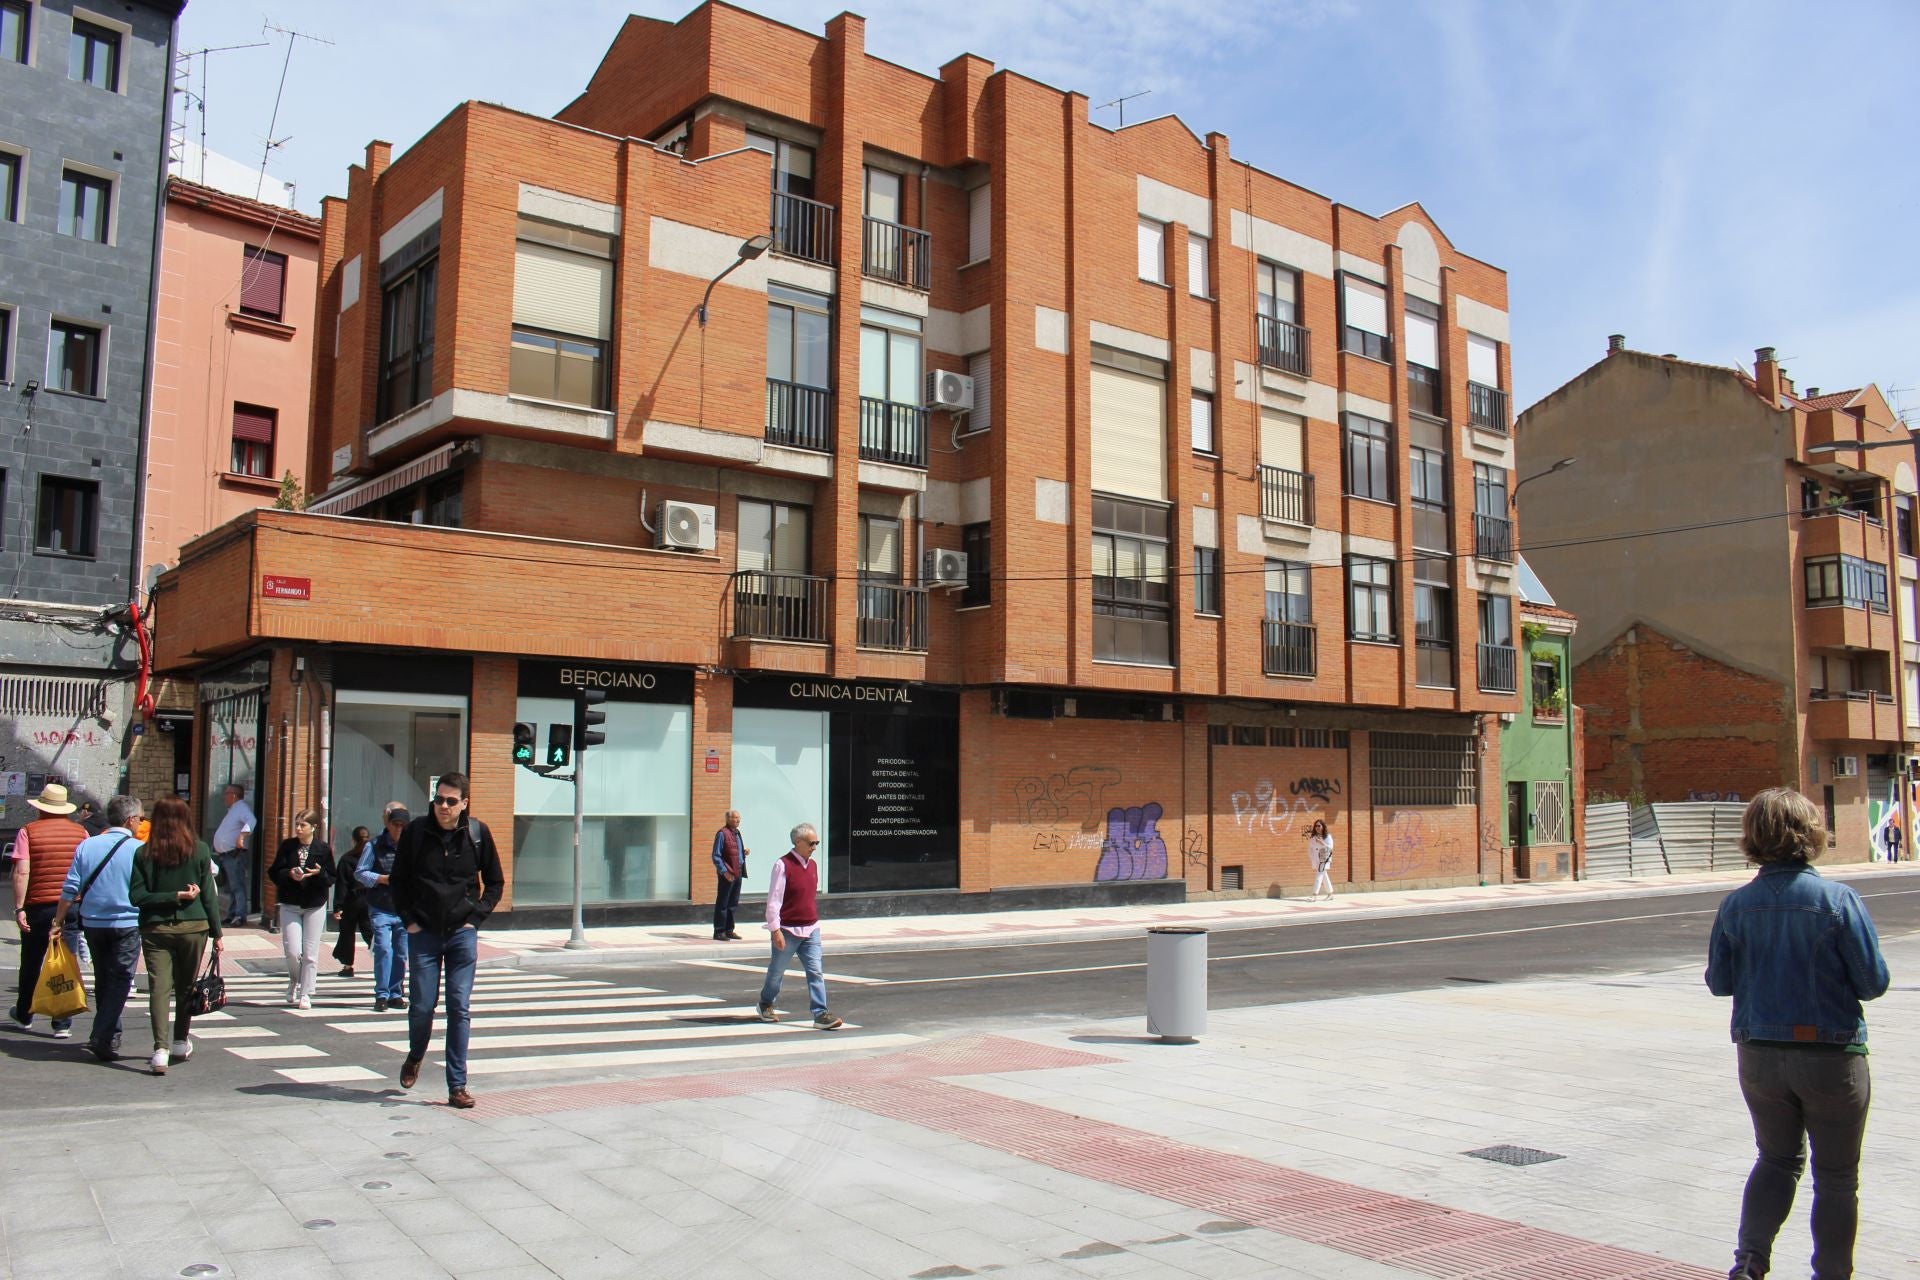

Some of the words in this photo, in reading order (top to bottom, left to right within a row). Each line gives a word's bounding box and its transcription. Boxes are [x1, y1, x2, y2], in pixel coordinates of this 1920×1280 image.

[275, 587, 302, 595] FERNANDO
[560, 668, 656, 689] BERCIANO
[789, 682, 852, 699] CLINICA
[855, 686, 913, 702] DENTAL
